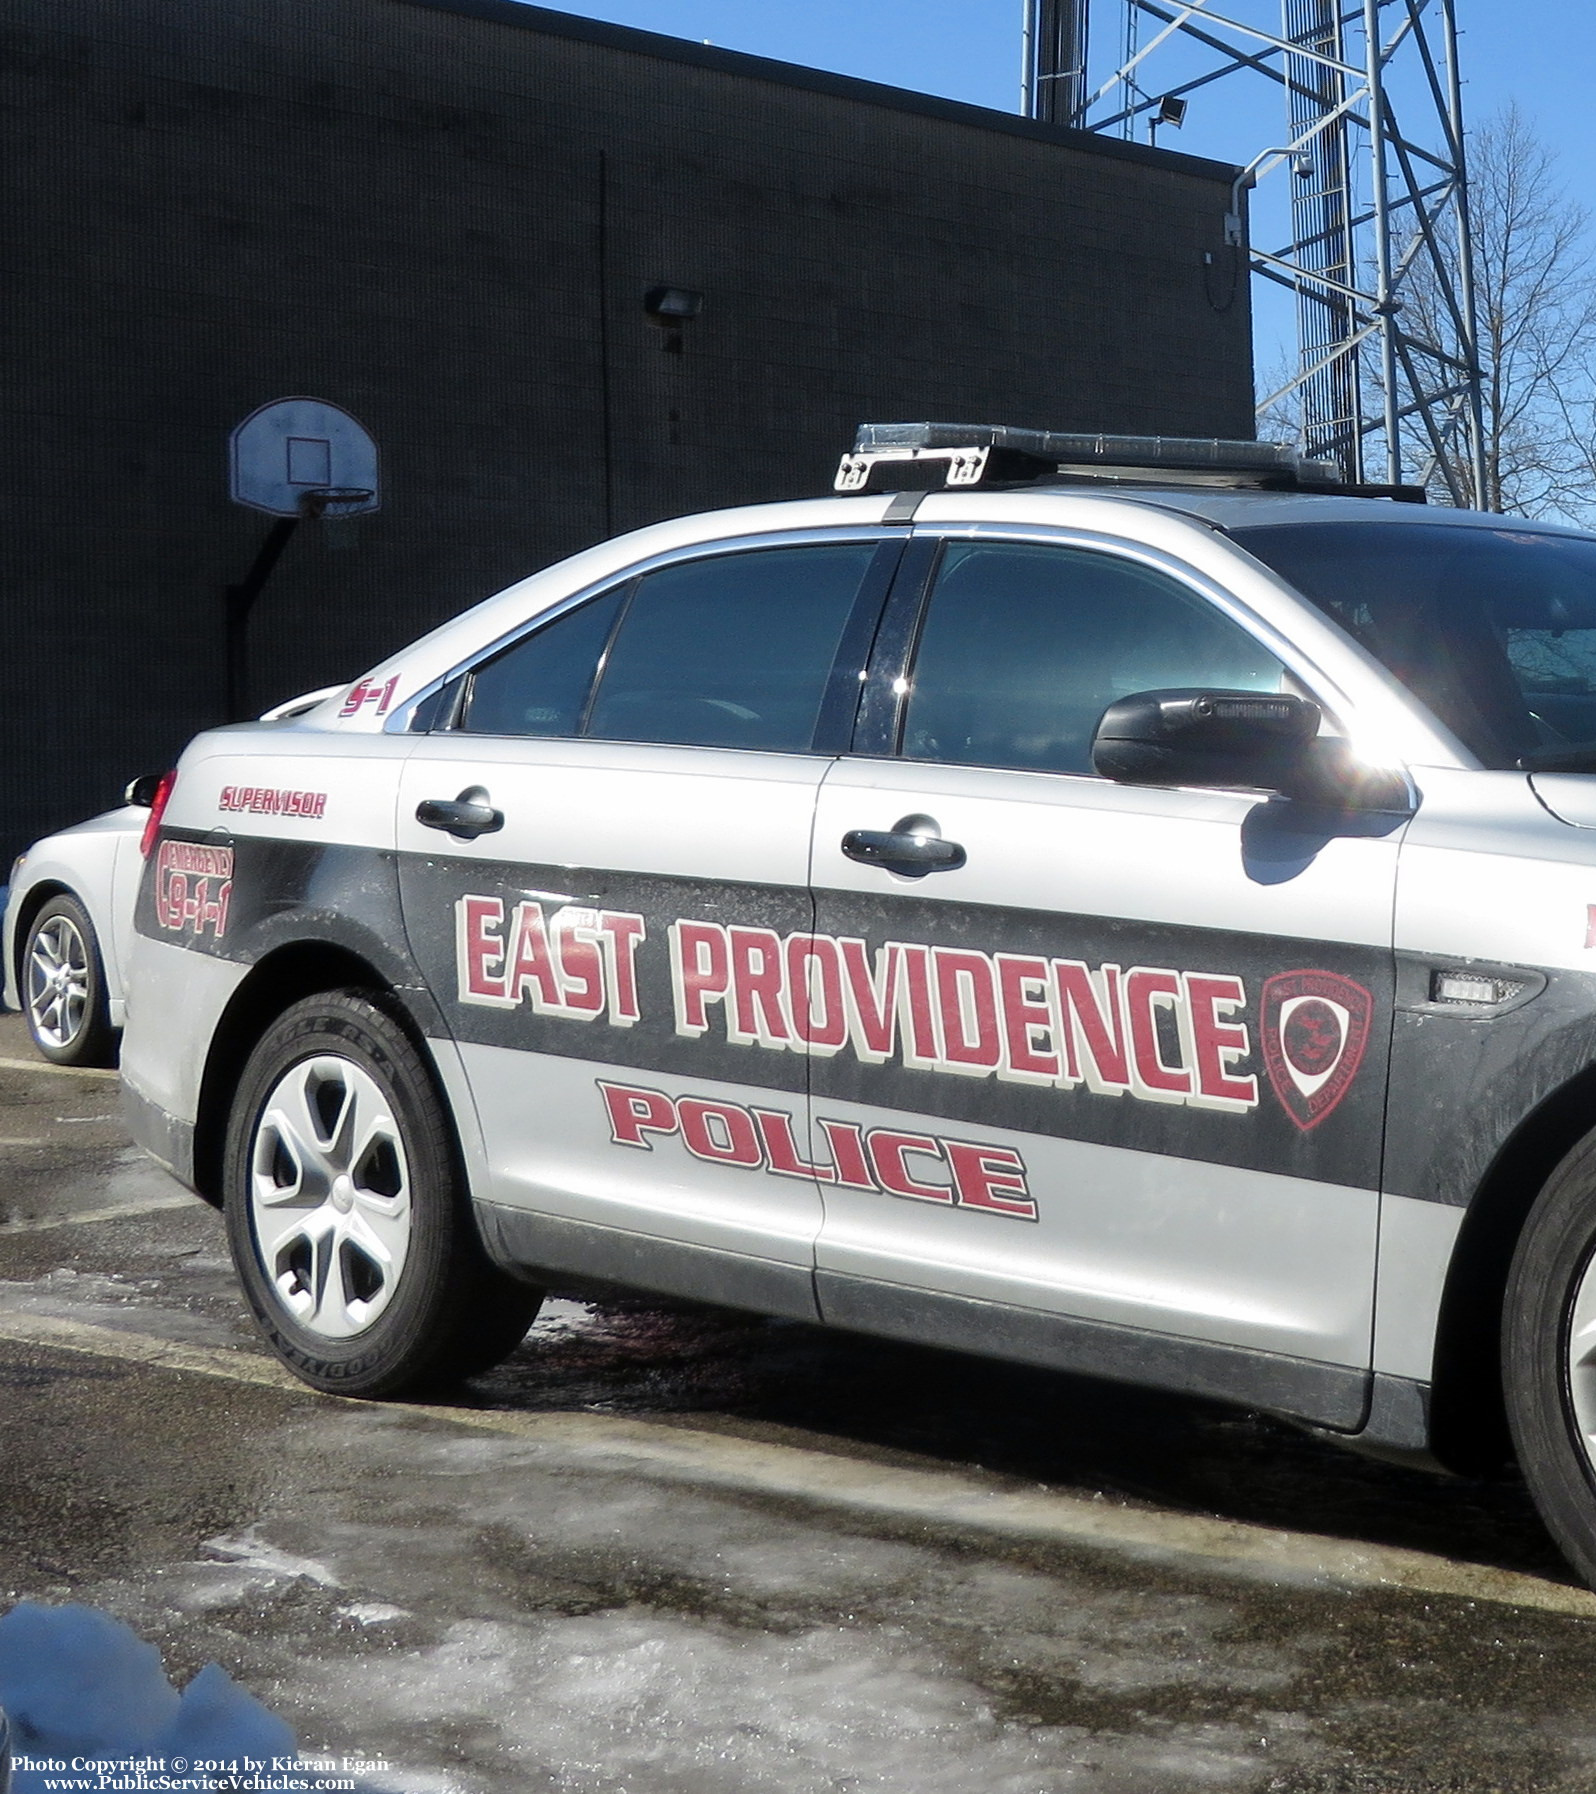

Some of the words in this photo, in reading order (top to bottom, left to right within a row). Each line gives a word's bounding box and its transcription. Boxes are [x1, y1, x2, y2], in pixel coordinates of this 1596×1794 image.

[219, 785, 327, 819] SUPERVISOR
[455, 894, 646, 1028] EAST
[667, 918, 1259, 1114] PROVIDENCE
[595, 1078, 1040, 1223] POLICE
